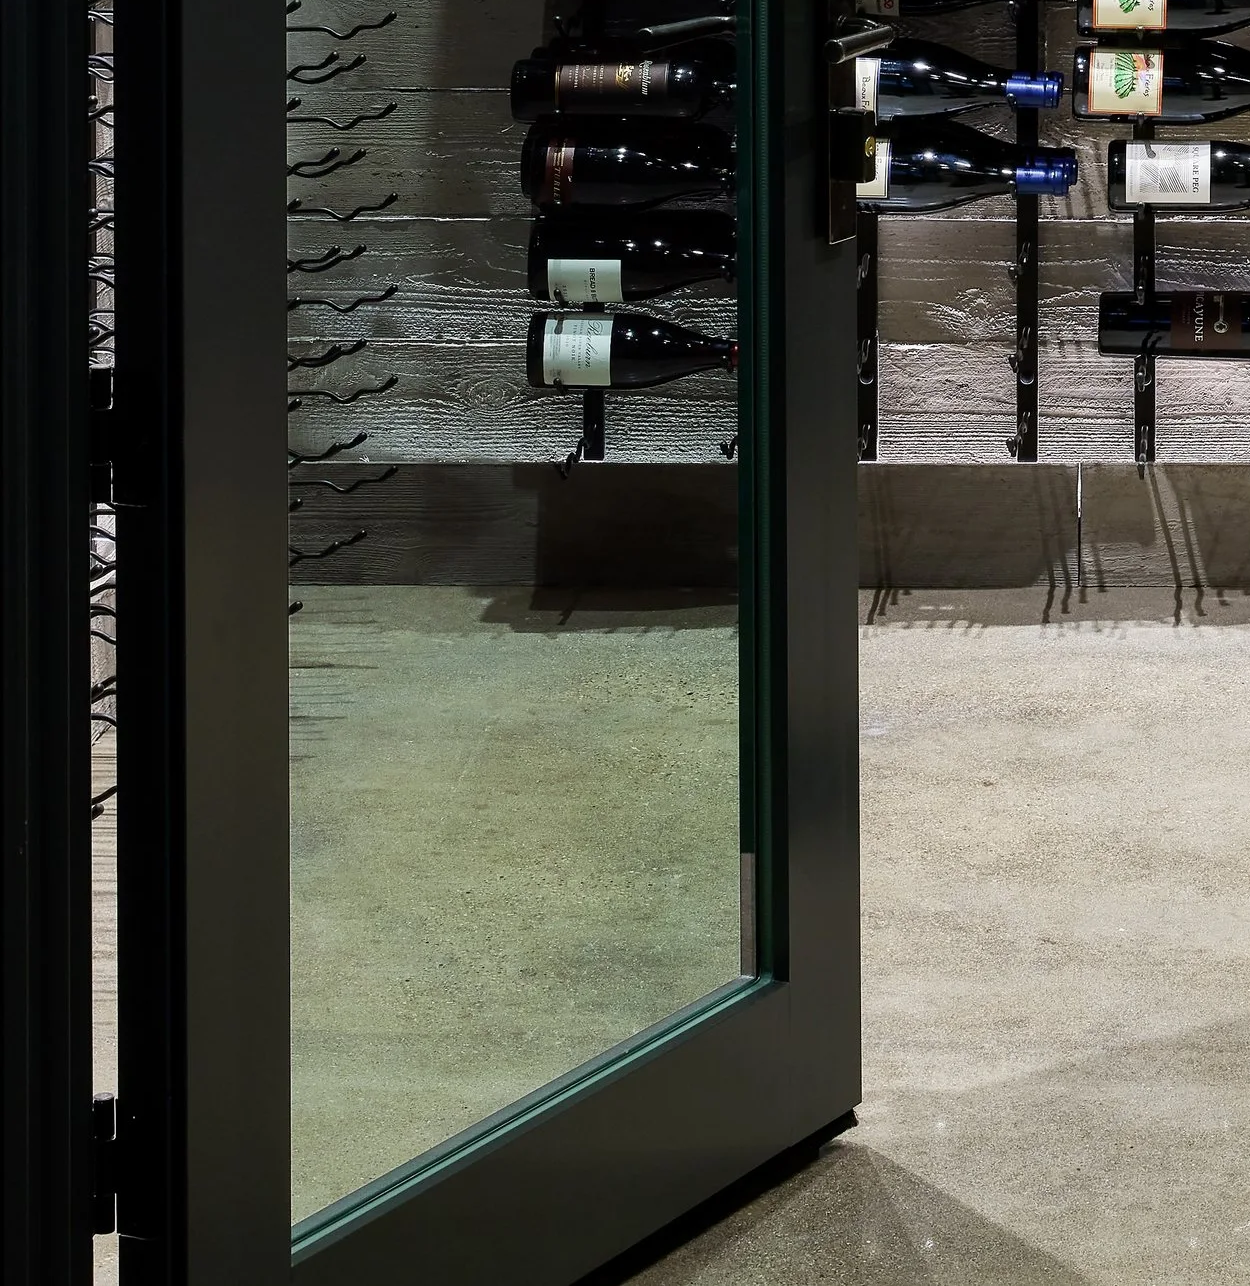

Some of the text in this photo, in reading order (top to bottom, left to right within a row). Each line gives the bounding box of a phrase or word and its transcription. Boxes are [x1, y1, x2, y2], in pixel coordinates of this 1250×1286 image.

[638, 59, 654, 96] Rosenblum
[860, 75, 871, 100] Beaux
[1191, 146, 1199, 176] SQUARE
[588, 267, 597, 290] BREAD
[1192, 291, 1205, 342] PICAYUNE
[584, 320, 604, 370] Raeburn
